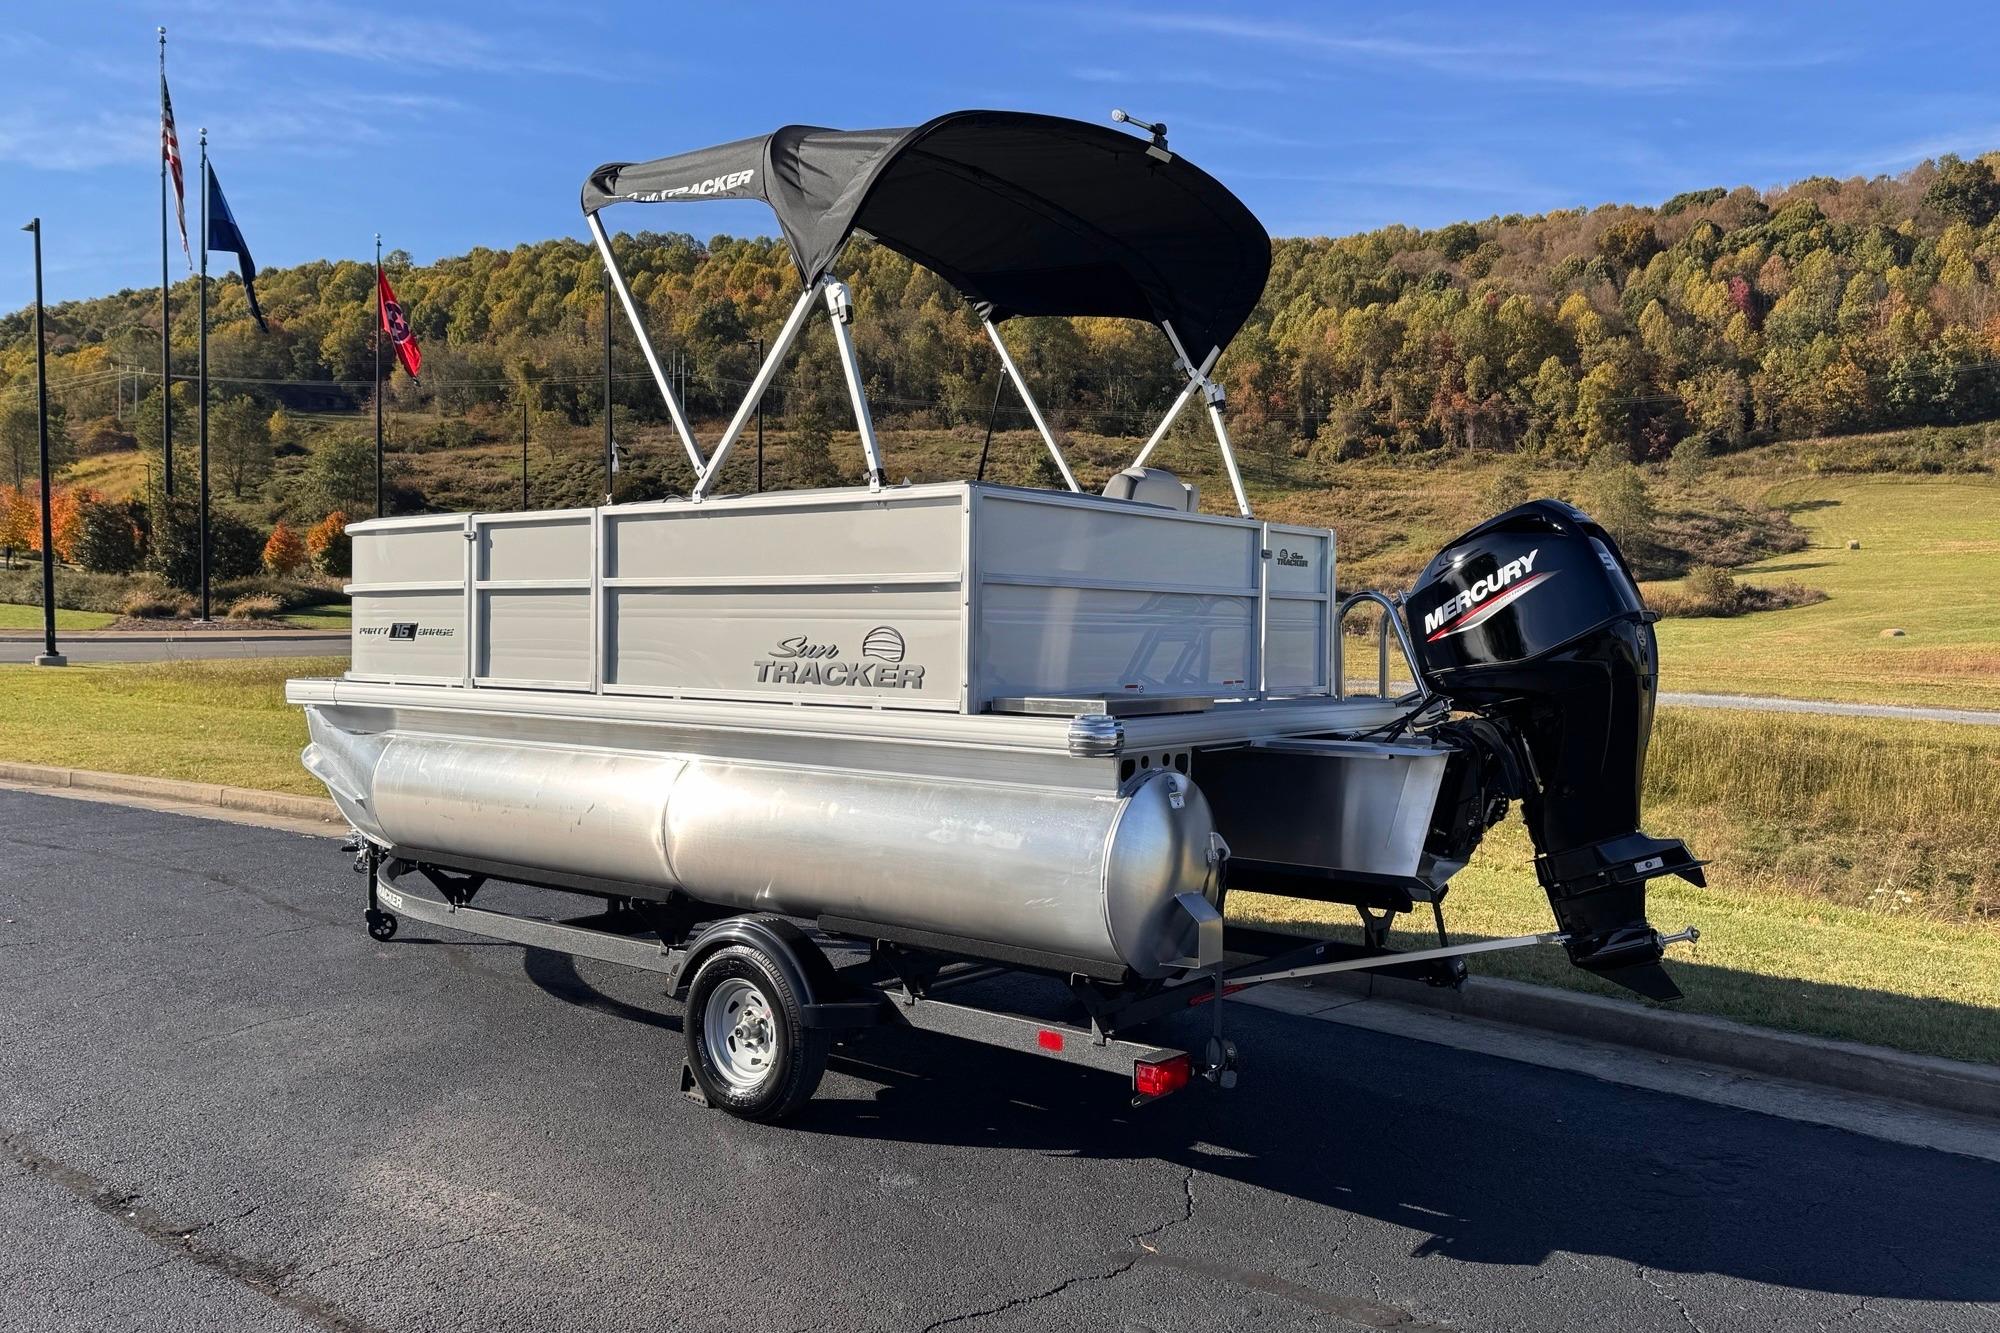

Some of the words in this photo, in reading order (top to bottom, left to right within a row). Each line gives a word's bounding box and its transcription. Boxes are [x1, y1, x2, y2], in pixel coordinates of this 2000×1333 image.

[1276, 558, 1309, 567] TRACKER
[1598, 552, 1617, 571] 5
[1424, 548, 1539, 635] MERCURY
[359, 627, 389, 635] PARTY
[394, 624, 411, 638] 16
[417, 628, 454, 637] BARGE
[768, 634, 840, 660] Sun
[753, 660, 926, 689] TRACKER
